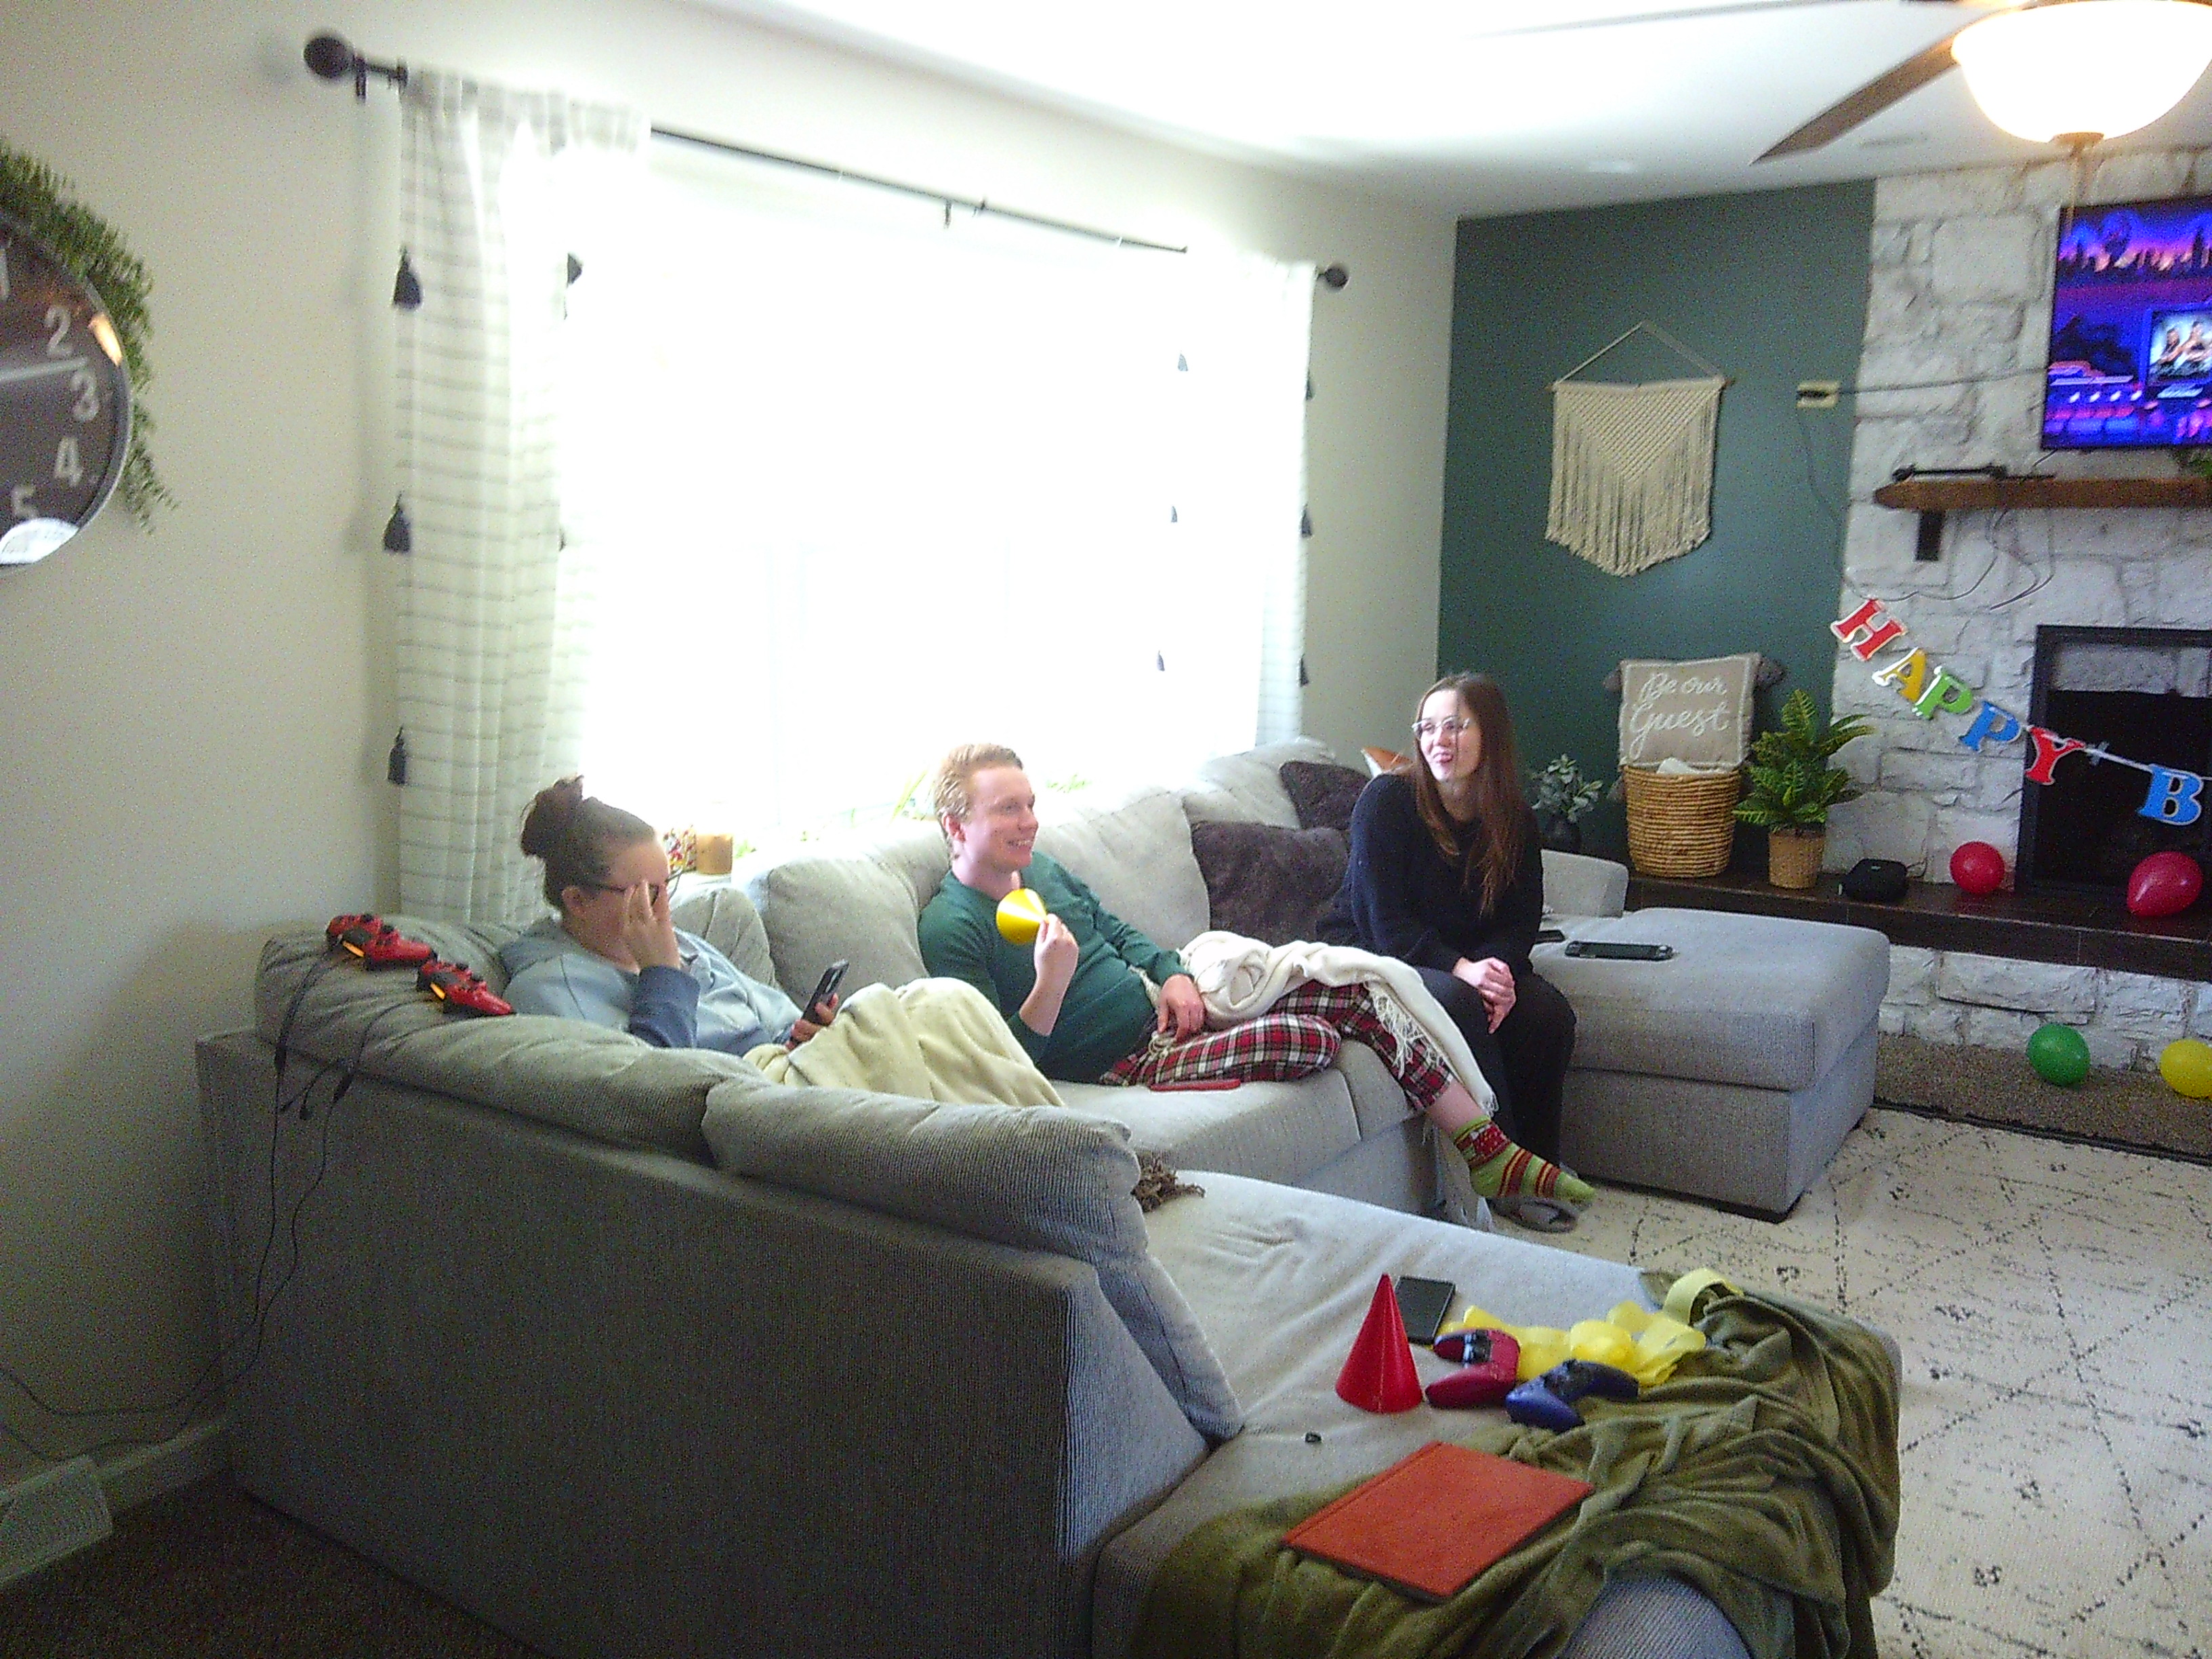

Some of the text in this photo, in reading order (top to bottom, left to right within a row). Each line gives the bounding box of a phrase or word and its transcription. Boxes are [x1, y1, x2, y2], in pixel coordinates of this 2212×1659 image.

[45, 306, 72, 358] 2
[70, 370, 99, 422] 3
[54, 436, 83, 488] 4
[11, 486, 37, 520] 5
[1639, 672, 1678, 703] Be
[1830, 599, 2085, 785] HAPPY
[1629, 701, 1731, 760] Guest
